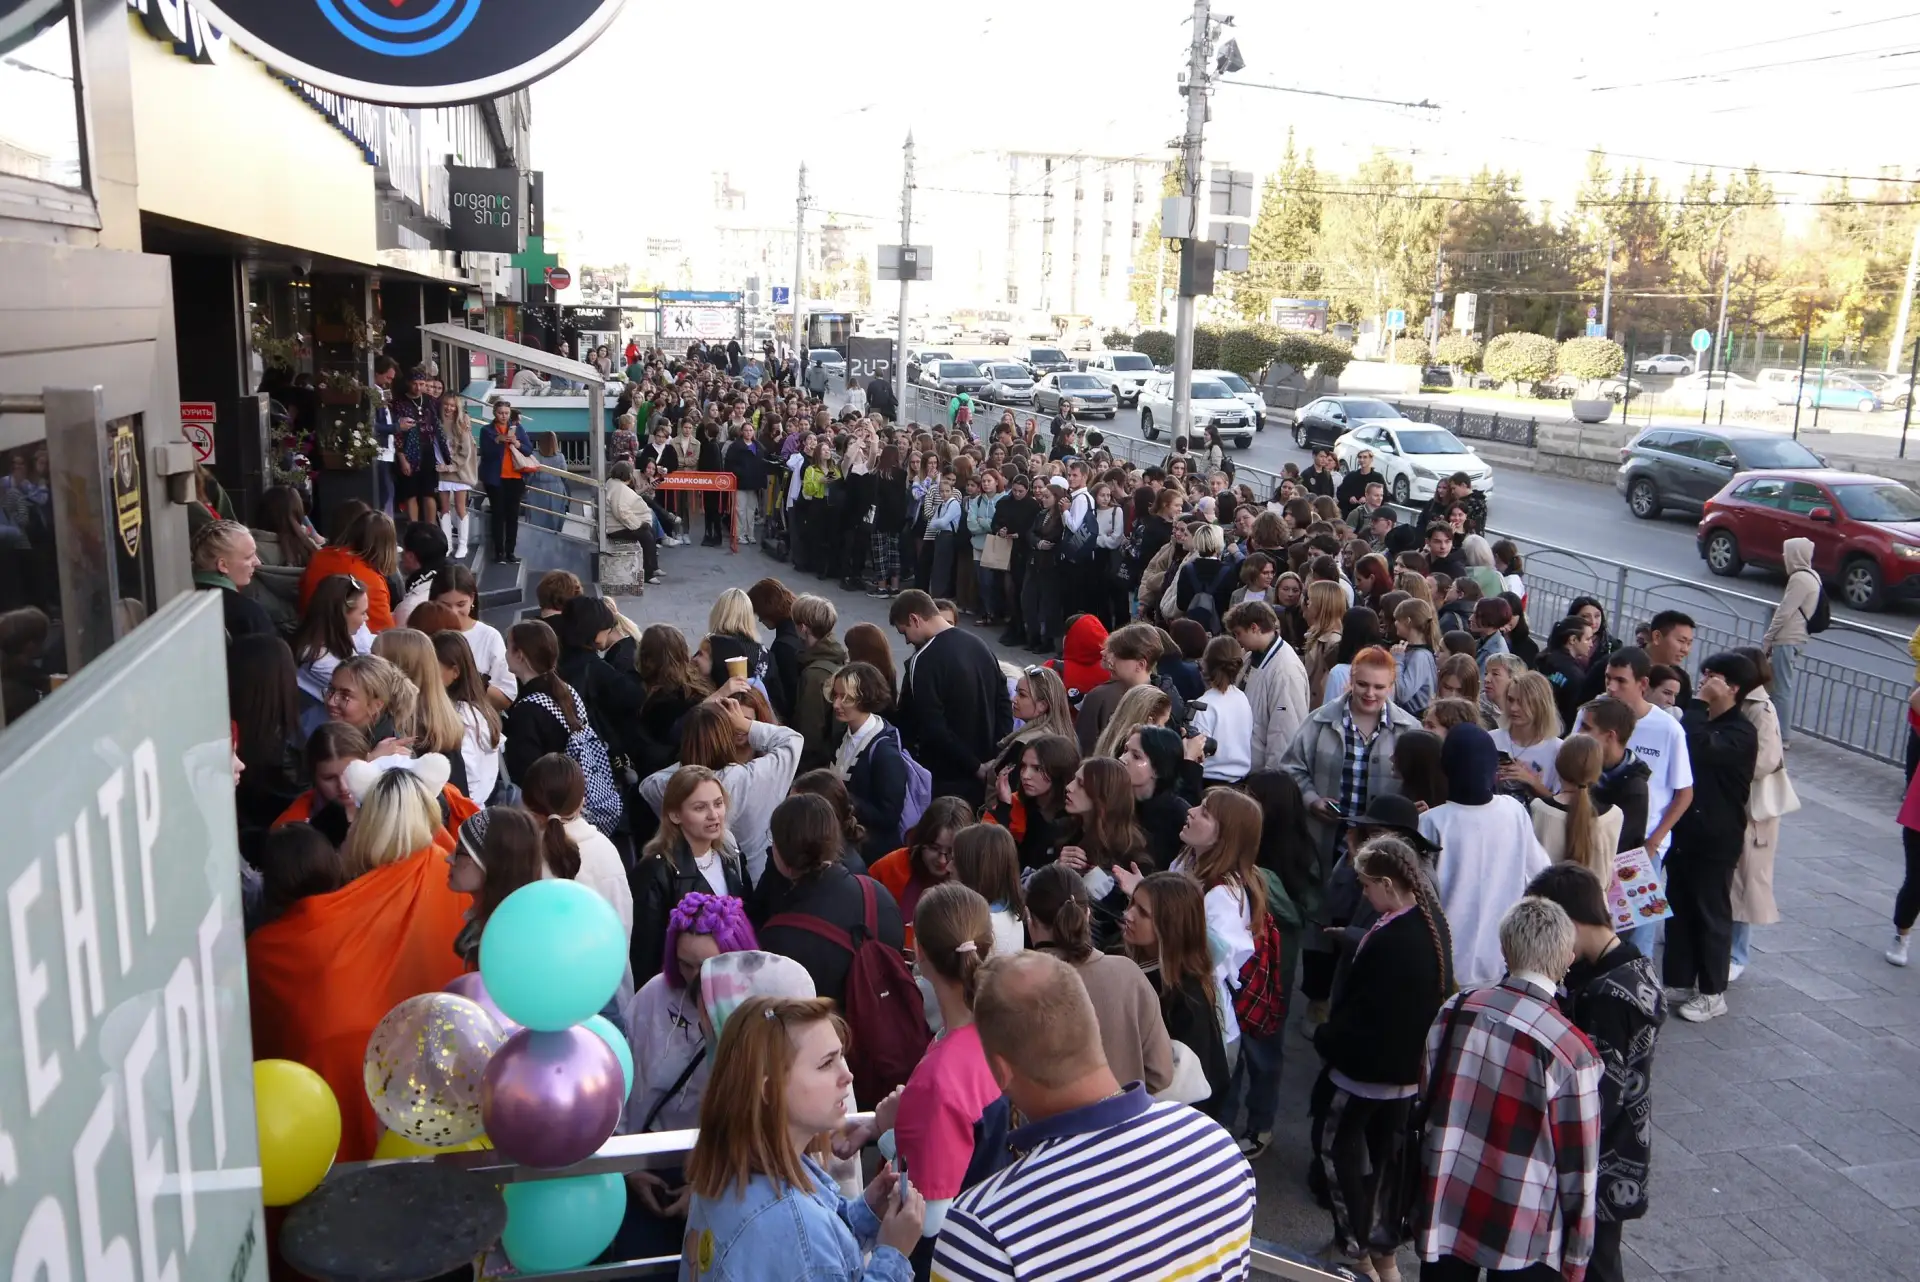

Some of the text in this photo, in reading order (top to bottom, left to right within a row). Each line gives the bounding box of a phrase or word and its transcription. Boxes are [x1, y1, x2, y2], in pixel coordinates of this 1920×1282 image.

[475, 208, 510, 227] shop
[575, 308, 605, 317] ТАБАК
[663, 477, 713, 485] ЛОПАРКОВКА
